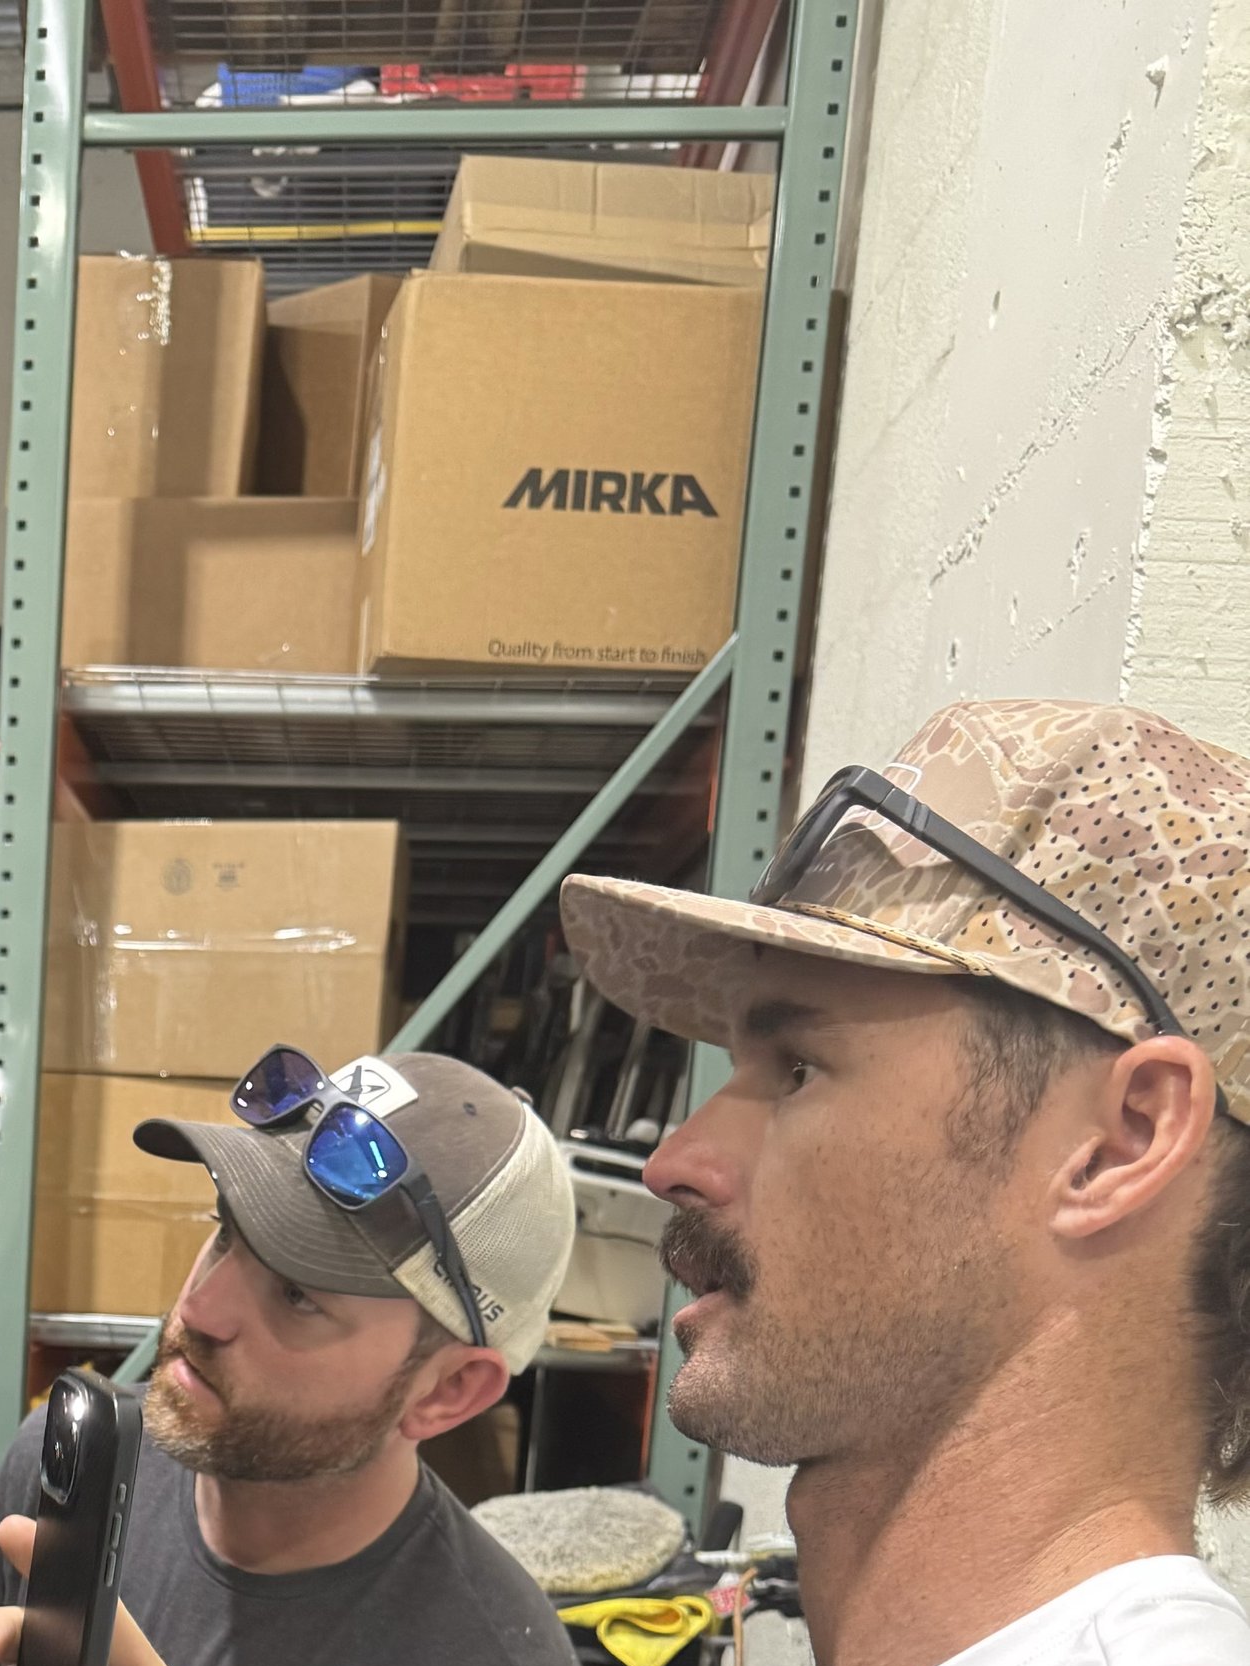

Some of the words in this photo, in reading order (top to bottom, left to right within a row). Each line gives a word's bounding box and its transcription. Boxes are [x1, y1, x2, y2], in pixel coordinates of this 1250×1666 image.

[502, 468, 720, 518] MIRKA
[488, 639, 549, 660] Quality
[552, 640, 592, 660] from
[597, 644, 635, 662] start
[639, 646, 657, 663] to
[661, 645, 708, 665] finish
